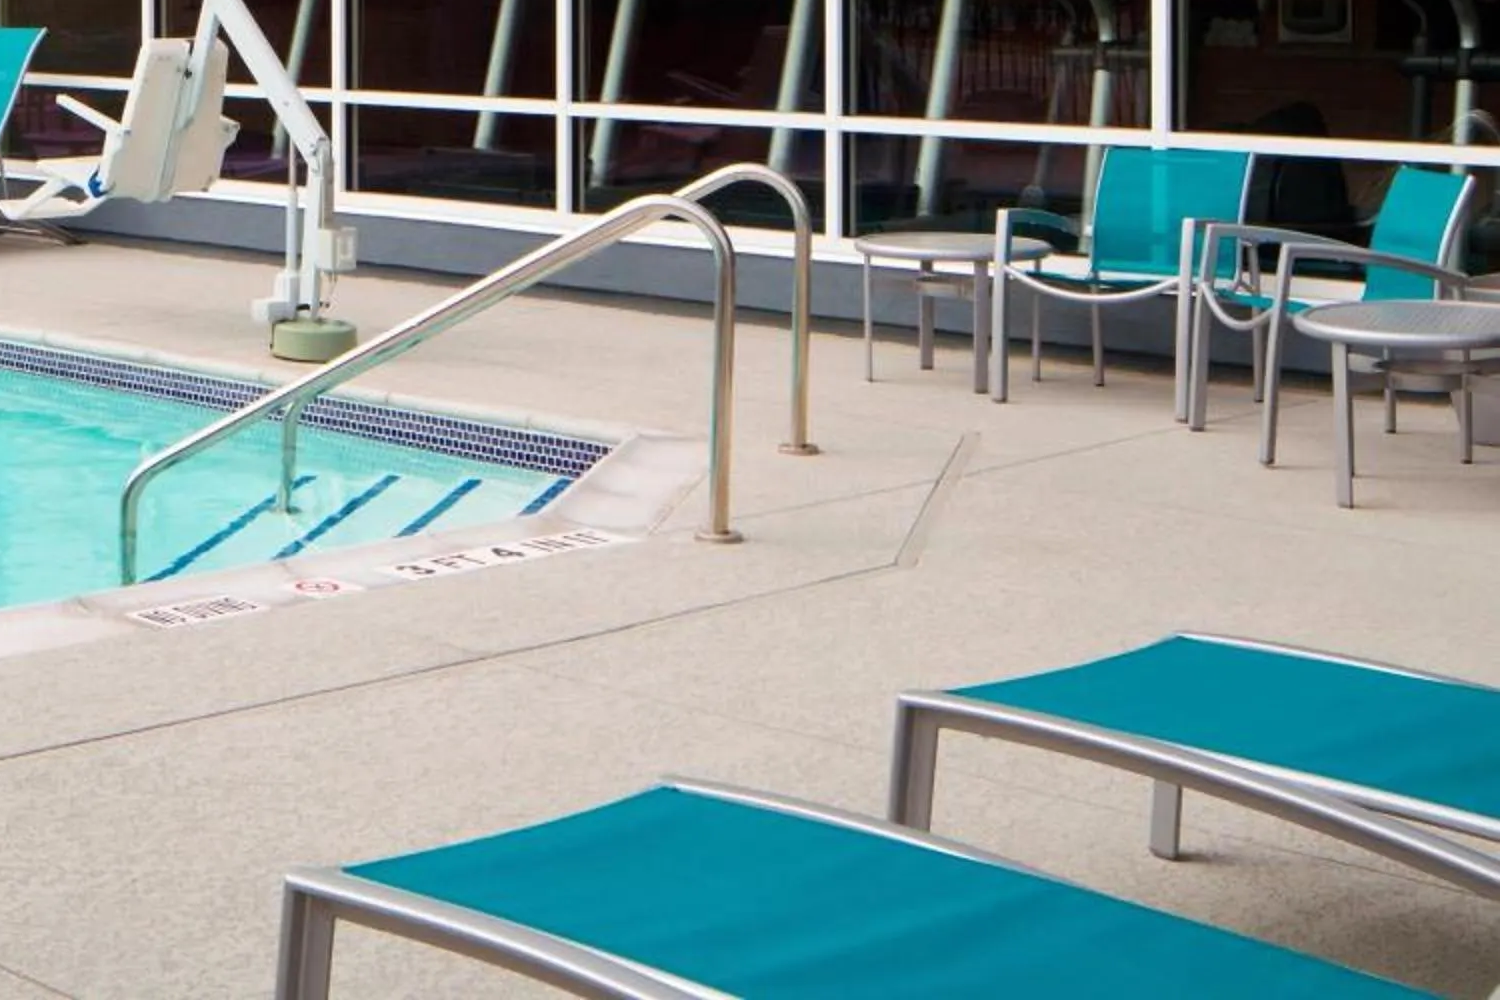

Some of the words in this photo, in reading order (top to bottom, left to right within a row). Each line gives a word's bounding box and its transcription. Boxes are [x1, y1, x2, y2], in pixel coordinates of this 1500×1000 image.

[396, 564, 436, 576] 3
[431, 553, 486, 569] FT
[491, 547, 525, 558] 4
